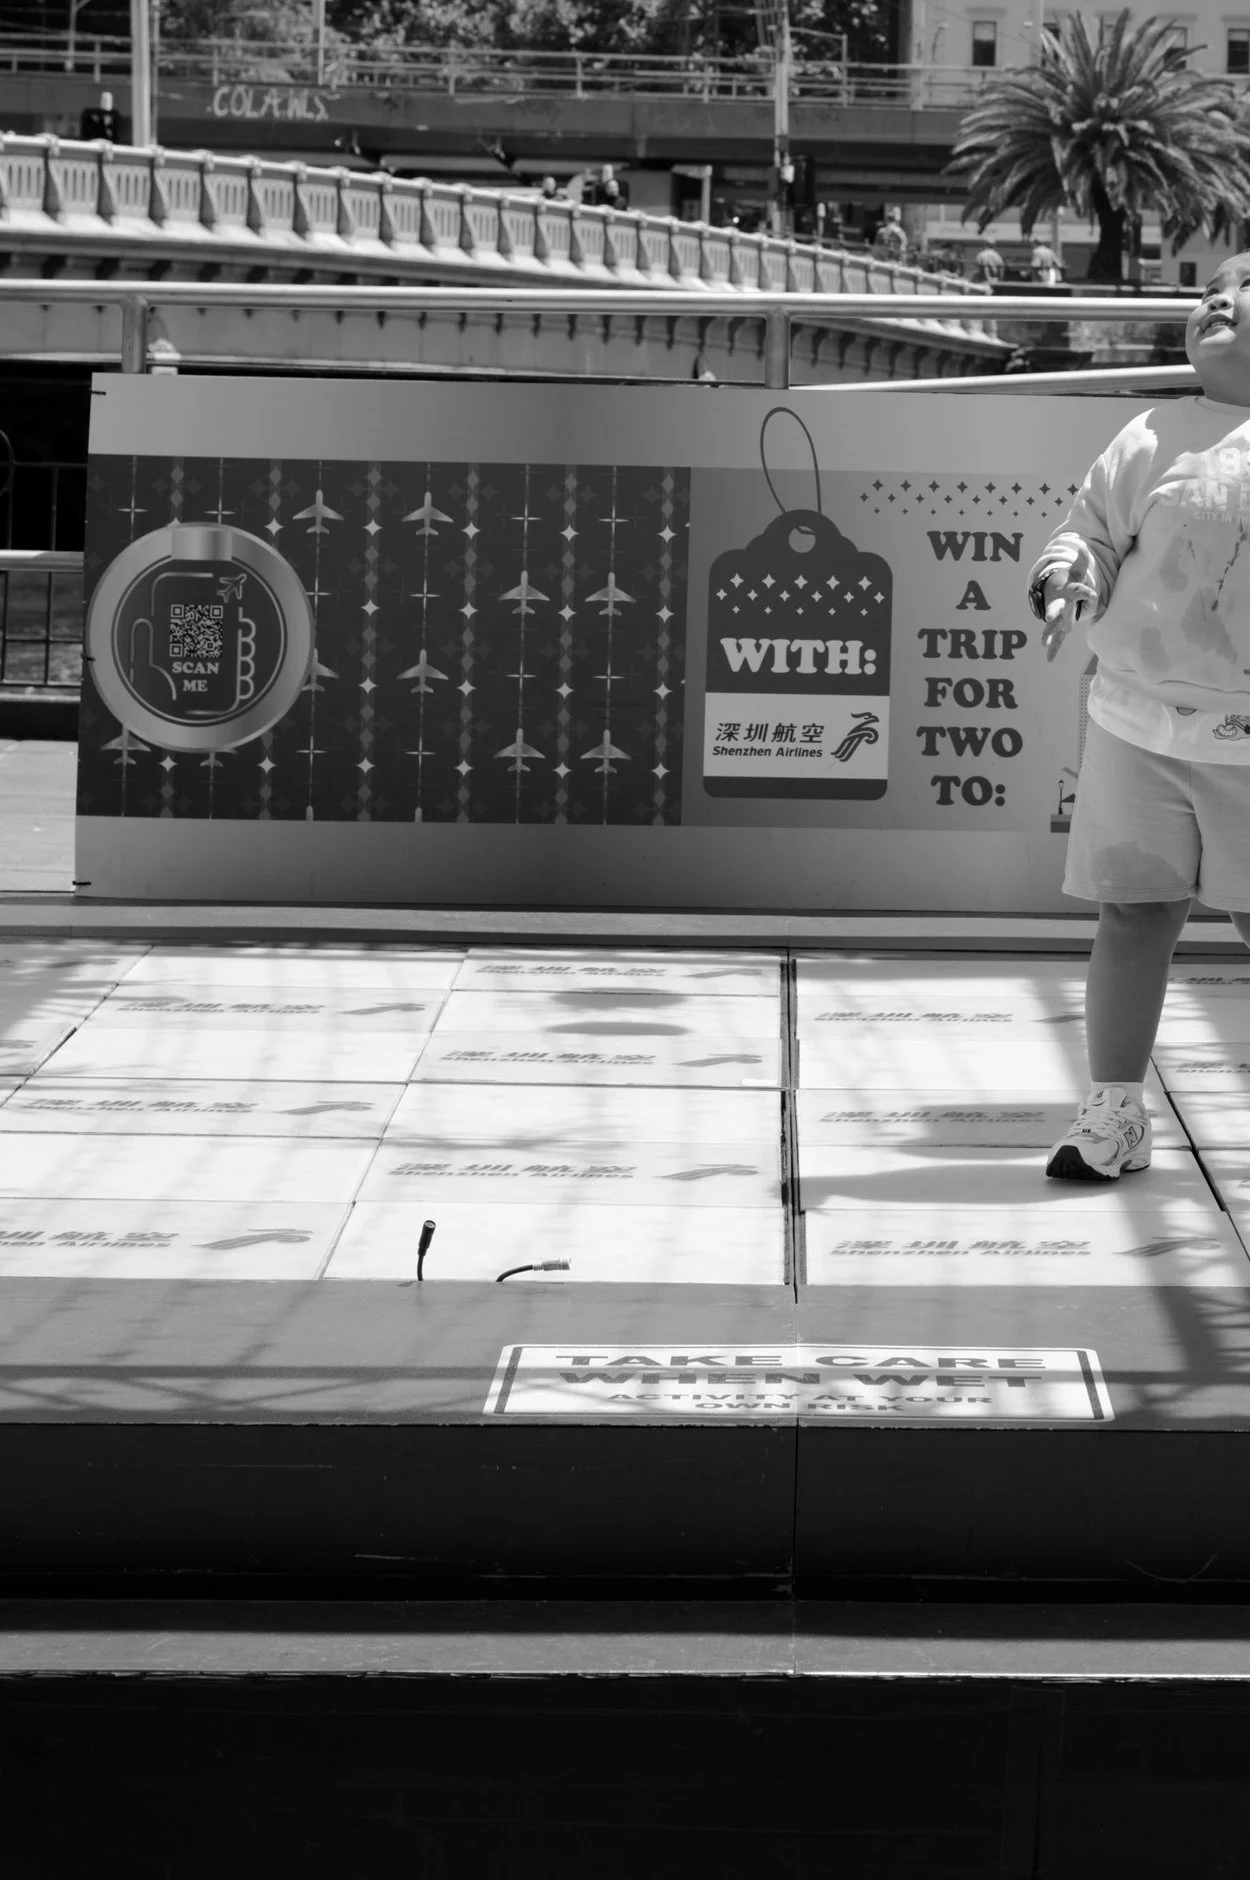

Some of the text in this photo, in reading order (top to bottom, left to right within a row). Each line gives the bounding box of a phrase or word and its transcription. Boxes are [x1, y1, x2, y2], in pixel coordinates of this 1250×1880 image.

[926, 530, 1024, 562] WIN
[955, 579, 992, 611] A
[917, 628, 1028, 660] TRIP
[720, 637, 877, 675] WITH:
[172, 661, 220, 675] SCAN
[182, 679, 208, 692] ME
[923, 677, 1019, 709] FOR
[715, 722, 825, 744] 深圳航空
[916, 726, 1024, 758] TWO
[712, 745, 823, 758] Shenzhen Airlines
[930, 775, 1006, 807] TO:
[0, 1231, 180, 1242] 圳航空
[556, 1355, 1047, 1369] TAKE CARE
[559, 1372, 1042, 1388] WHEN WET
[807, 1403, 905, 1411] RISK
[880, 1396, 994, 1404] YOUR
